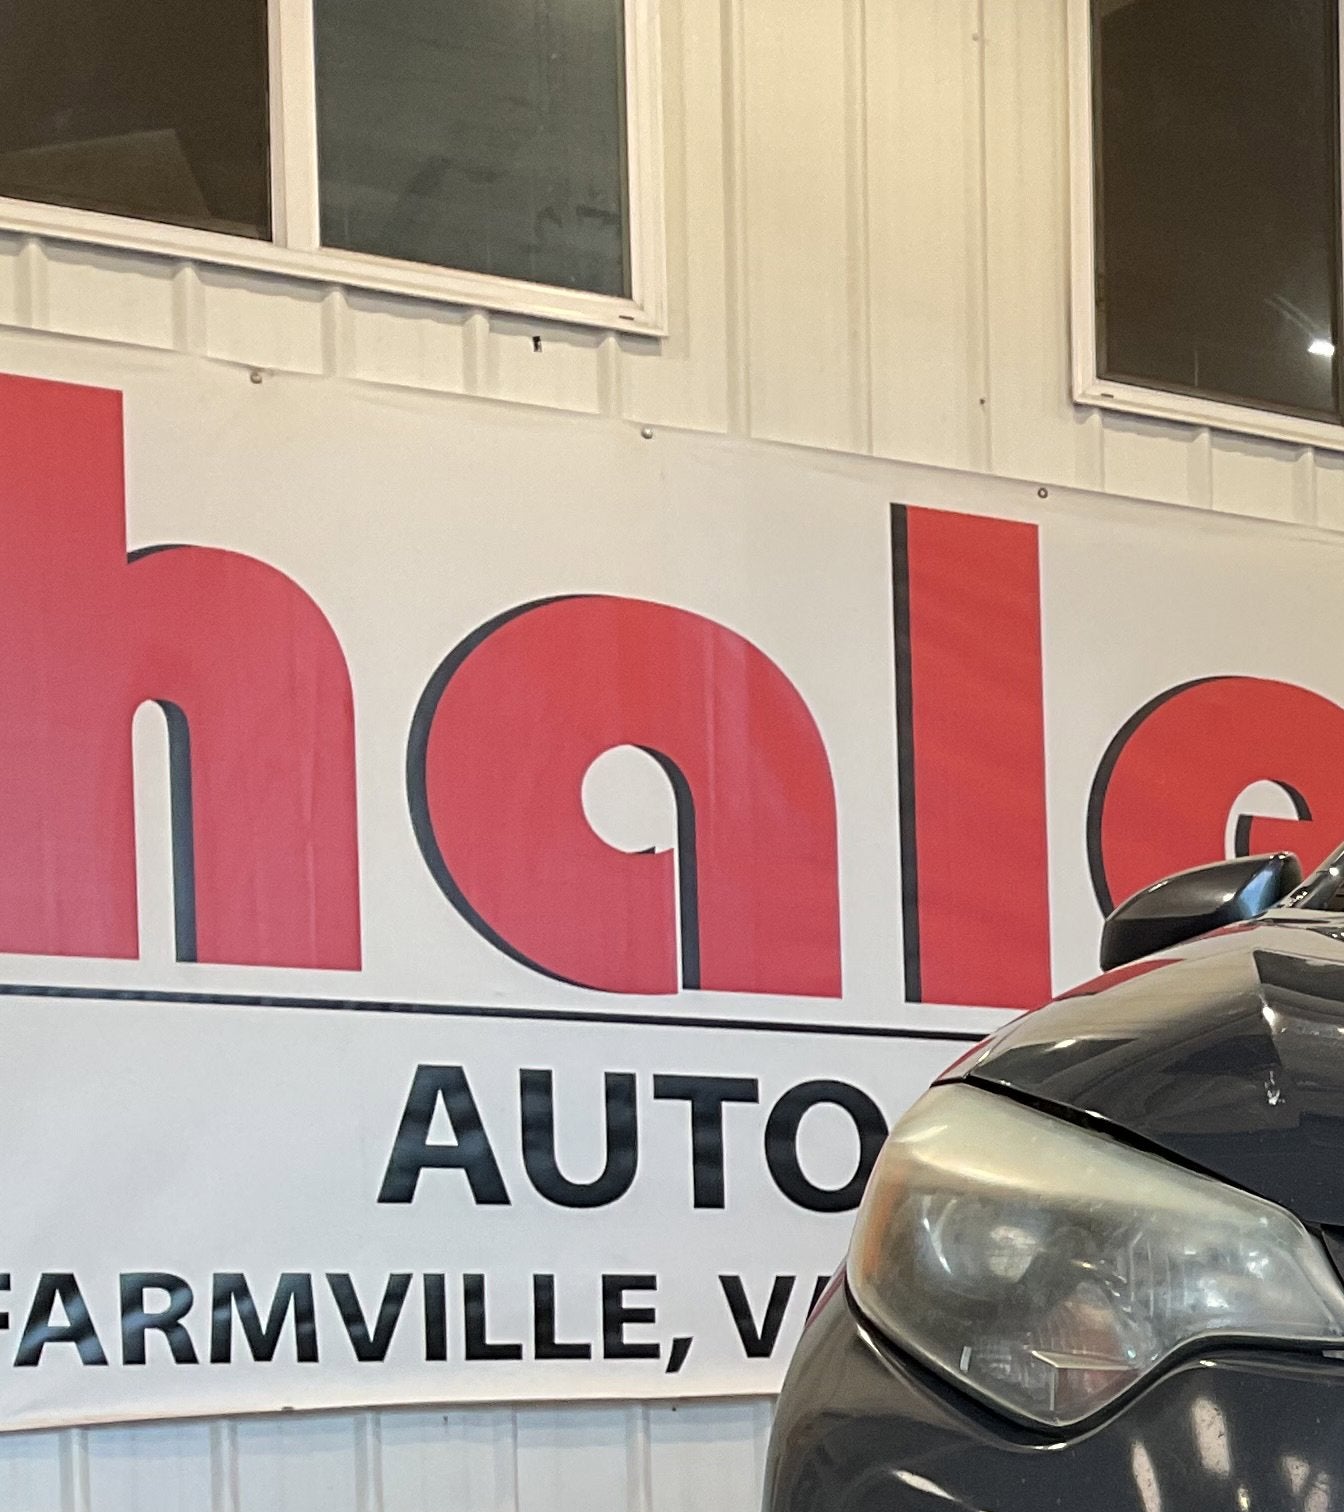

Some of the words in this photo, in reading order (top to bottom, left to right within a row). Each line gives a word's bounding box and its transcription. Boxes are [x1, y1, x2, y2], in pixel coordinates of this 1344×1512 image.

[377, 1064, 890, 1213] AUTO
[0, 1272, 693, 1374] ARMVILLE,
[718, 1274, 834, 1359] V
